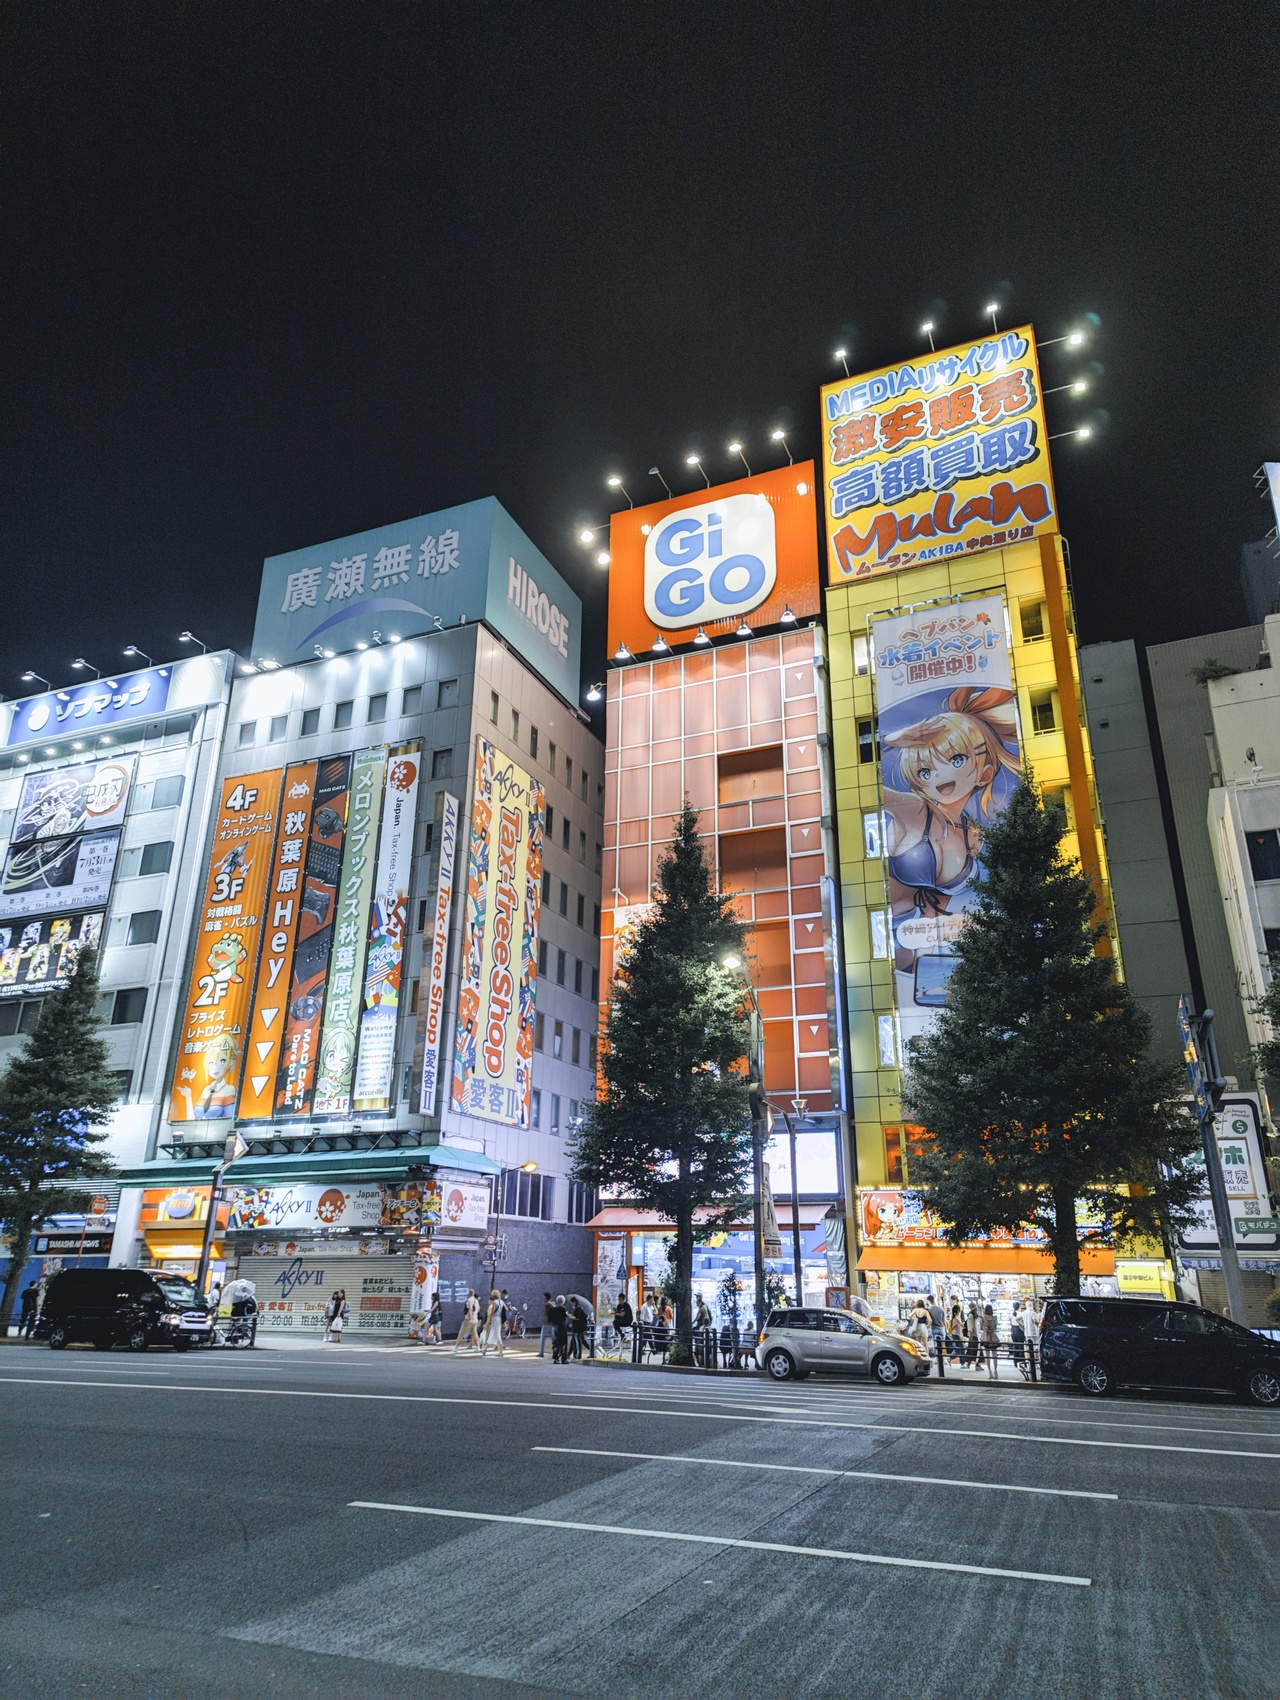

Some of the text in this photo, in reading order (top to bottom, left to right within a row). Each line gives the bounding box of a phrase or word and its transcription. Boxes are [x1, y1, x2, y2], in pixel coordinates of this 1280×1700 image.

[828, 332, 1028, 420] MEDIAリサイクル
[831, 370, 1033, 463] 激安販売
[831, 420, 1038, 517] 高額買取
[833, 481, 1054, 574] Mulan
[856, 525, 1035, 576] ムーラン AKIBA 中央通り店
[281, 529, 460, 614] 廣瀬無線
[507, 556, 569, 658] HIROSE
[901, 616, 976, 642] ヘブバン
[879, 629, 1003, 668] 水着イベント
[55, 682, 152, 723] ソフマップ
[226, 784, 258, 811] 4F
[493, 764, 524, 803] AKKY
[219, 824, 272, 841] オンラインゲーム
[221, 811, 272, 828] カードゲーム
[443, 798, 456, 867] AKKY
[387, 797, 404, 897] Japan. Tax-free Shop
[210, 872, 245, 902] 3F
[266, 811, 307, 989] 秋葉原 Hey
[206, 904, 242, 919] 対戦格闘
[432, 886, 451, 980] Tax-free
[483, 806, 524, 1078] Tax-free Shop
[193, 975, 228, 1007] 2F
[190, 1009, 227, 1024] プライズ
[426, 983, 443, 1045] Shop
[187, 1023, 241, 1039] レトロゲーム
[184, 1040, 230, 1054] 音楽ゲーム
[285, 1034, 301, 1105] Dare to Lead
[294, 1029, 312, 1109] MAD CATZ
[316, 1098, 348, 1110] 地下 1F
[169, 1199, 191, 1211] Hey
[270, 1189, 304, 1225] AKKY
[353, 1201, 381, 1210] Tax-free
[356, 1190, 382, 1200] Japan.
[387, 1198, 418, 1209] アッキー2
[468, 1204, 486, 1213] Tax-free
[470, 1193, 486, 1202] Japan.
[362, 1210, 380, 1220] Shop
[473, 1213, 485, 1222] Shop
[1248, 1220, 1278, 1230] モバデコ
[739, 1232, 749, 1241] Get
[894, 1227, 935, 1240] ムーラン
[340, 1245, 354, 1253] Shop
[274, 1257, 314, 1298] AKKY
